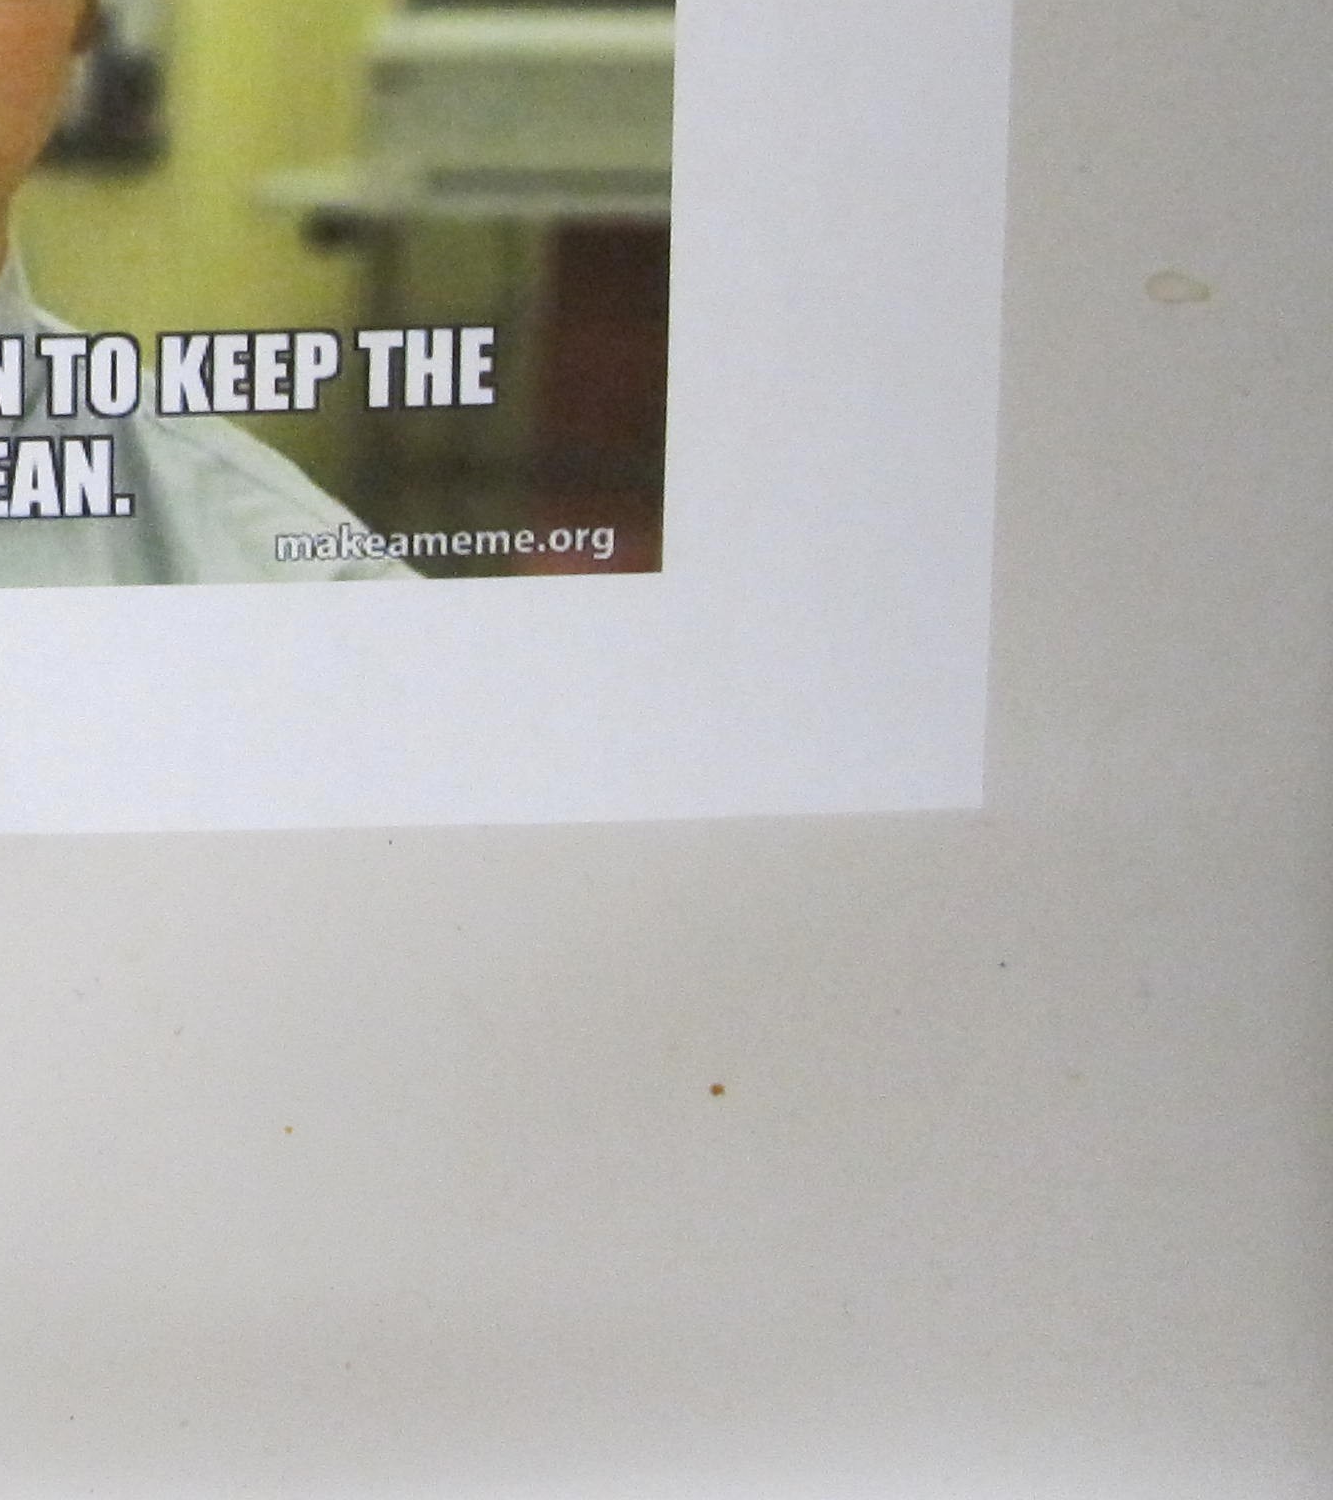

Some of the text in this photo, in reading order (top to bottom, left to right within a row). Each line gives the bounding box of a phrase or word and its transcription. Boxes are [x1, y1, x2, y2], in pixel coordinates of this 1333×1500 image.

[38, 332, 141, 419] TO
[156, 329, 341, 415] KEEP
[357, 325, 496, 409] THE
[274, 521, 619, 562] makeameme.org
